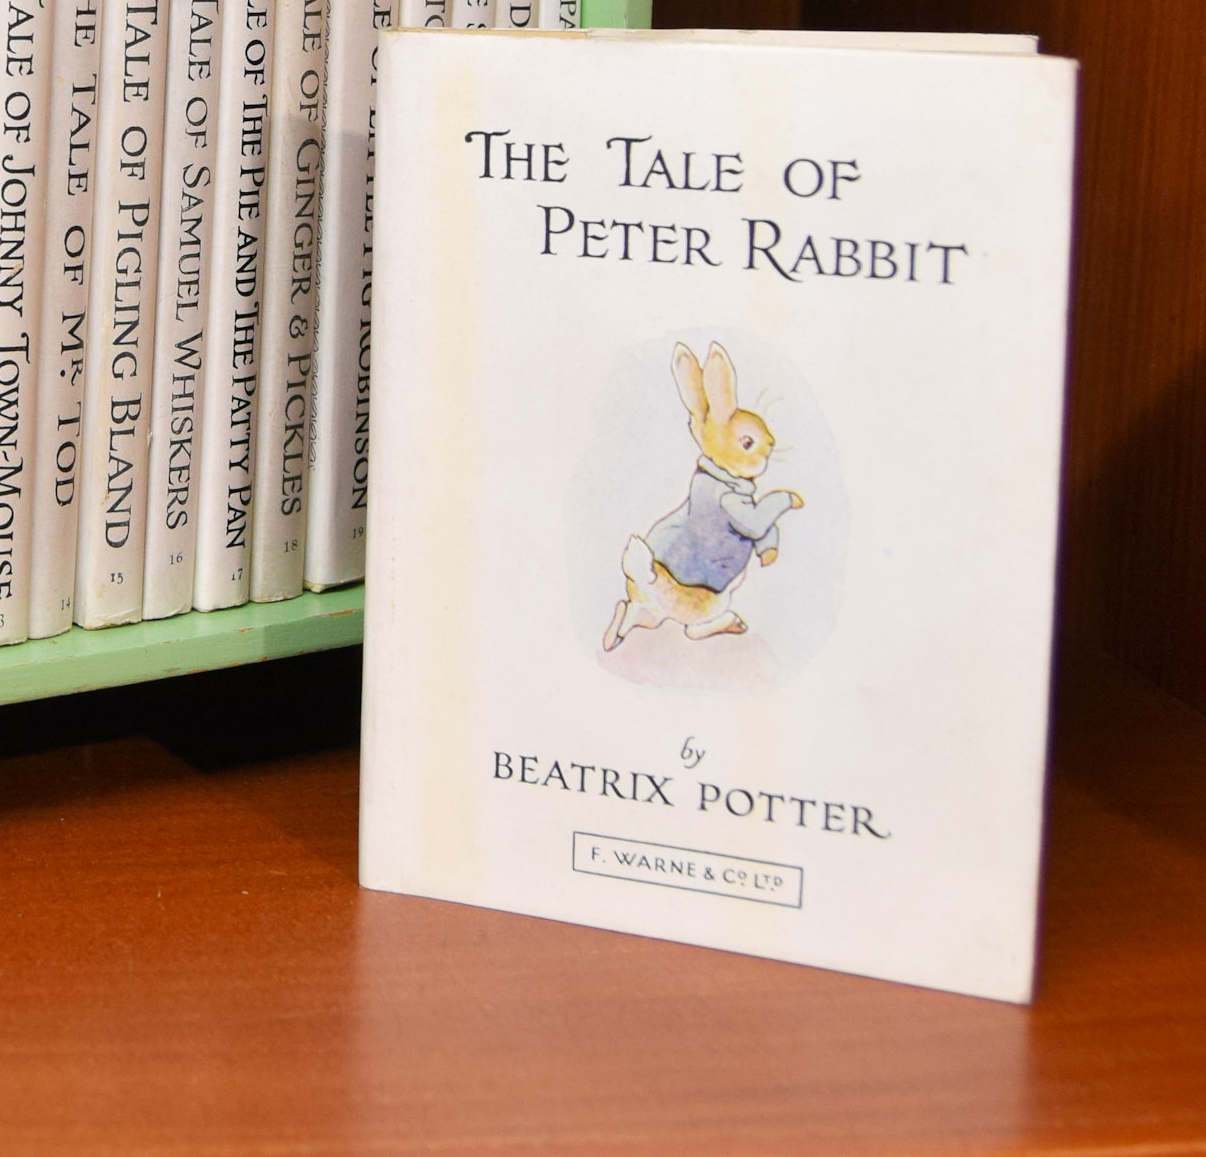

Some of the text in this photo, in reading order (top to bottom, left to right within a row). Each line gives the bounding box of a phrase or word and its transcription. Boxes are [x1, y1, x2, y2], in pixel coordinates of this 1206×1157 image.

[244, 40, 265, 85] OF
[4, 92, 31, 143] OF
[185, 97, 208, 148] OF
[241, 94, 268, 156] THE
[300, 70, 319, 122] OF
[68, 74, 97, 196] TALE
[120, 126, 147, 180] OF
[465, 130, 860, 200] THE TALE OF
[238, 165, 265, 221] PIE
[292, 138, 321, 305] GINGER
[64, 226, 85, 285] OF
[176, 164, 211, 322] SAMUEL
[236, 226, 258, 297] AND
[537, 205, 968, 284] PETER RABBIT
[112, 198, 150, 380] PIGLING
[233, 301, 259, 369] THE
[289, 315, 309, 339] &
[55, 401, 81, 506] TOD
[166, 329, 203, 529] WHISKERS
[229, 374, 257, 474] PATTY
[281, 352, 313, 516] PICKLES
[105, 394, 142, 548] BLAND
[226, 481, 252, 548] PAN
[352, 526, 364, 540] 19
[169, 552, 183, 565] 16
[231, 567, 244, 582] 17
[283, 539, 298, 553] 18
[60, 596, 71, 611] 14
[110, 572, 123, 584] 15
[680, 736, 706, 769] by
[494, 751, 892, 839] BEATRIX POTTER
[591, 847, 606, 863] F.
[614, 851, 695, 877] WARNE
[703, 867, 715, 880] &
